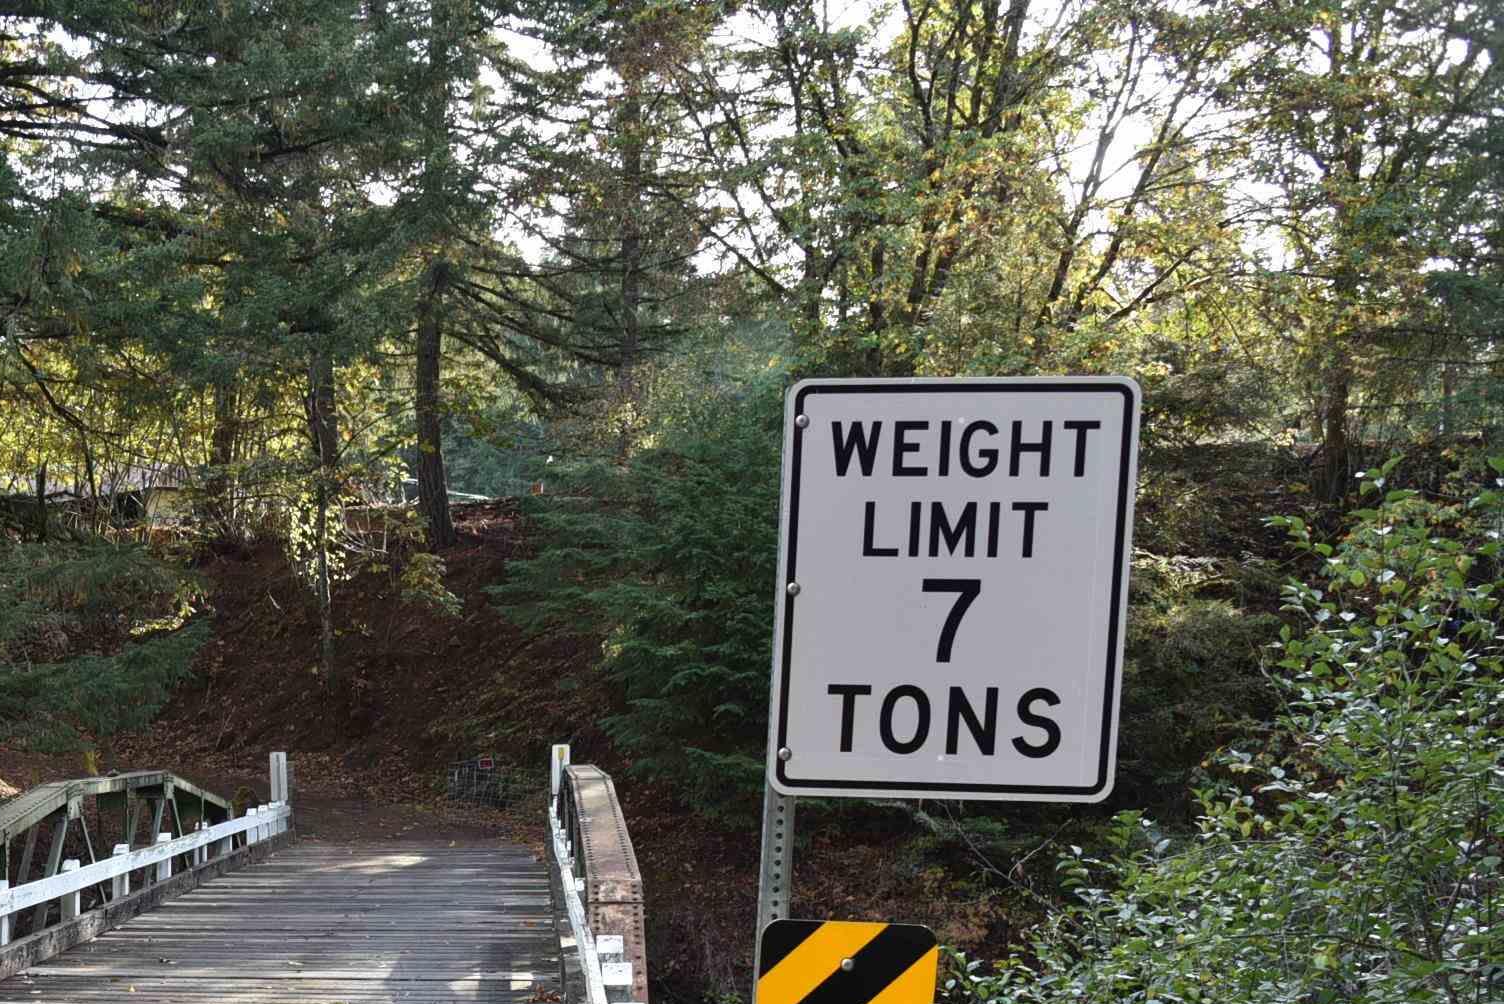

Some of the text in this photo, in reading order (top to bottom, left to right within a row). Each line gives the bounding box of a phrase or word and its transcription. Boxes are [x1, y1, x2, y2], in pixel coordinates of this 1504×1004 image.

[831, 420, 1101, 478] WEIGHT
[862, 501, 1049, 558] LIMIT
[921, 578, 982, 663] 7
[827, 684, 1062, 759] TONS
